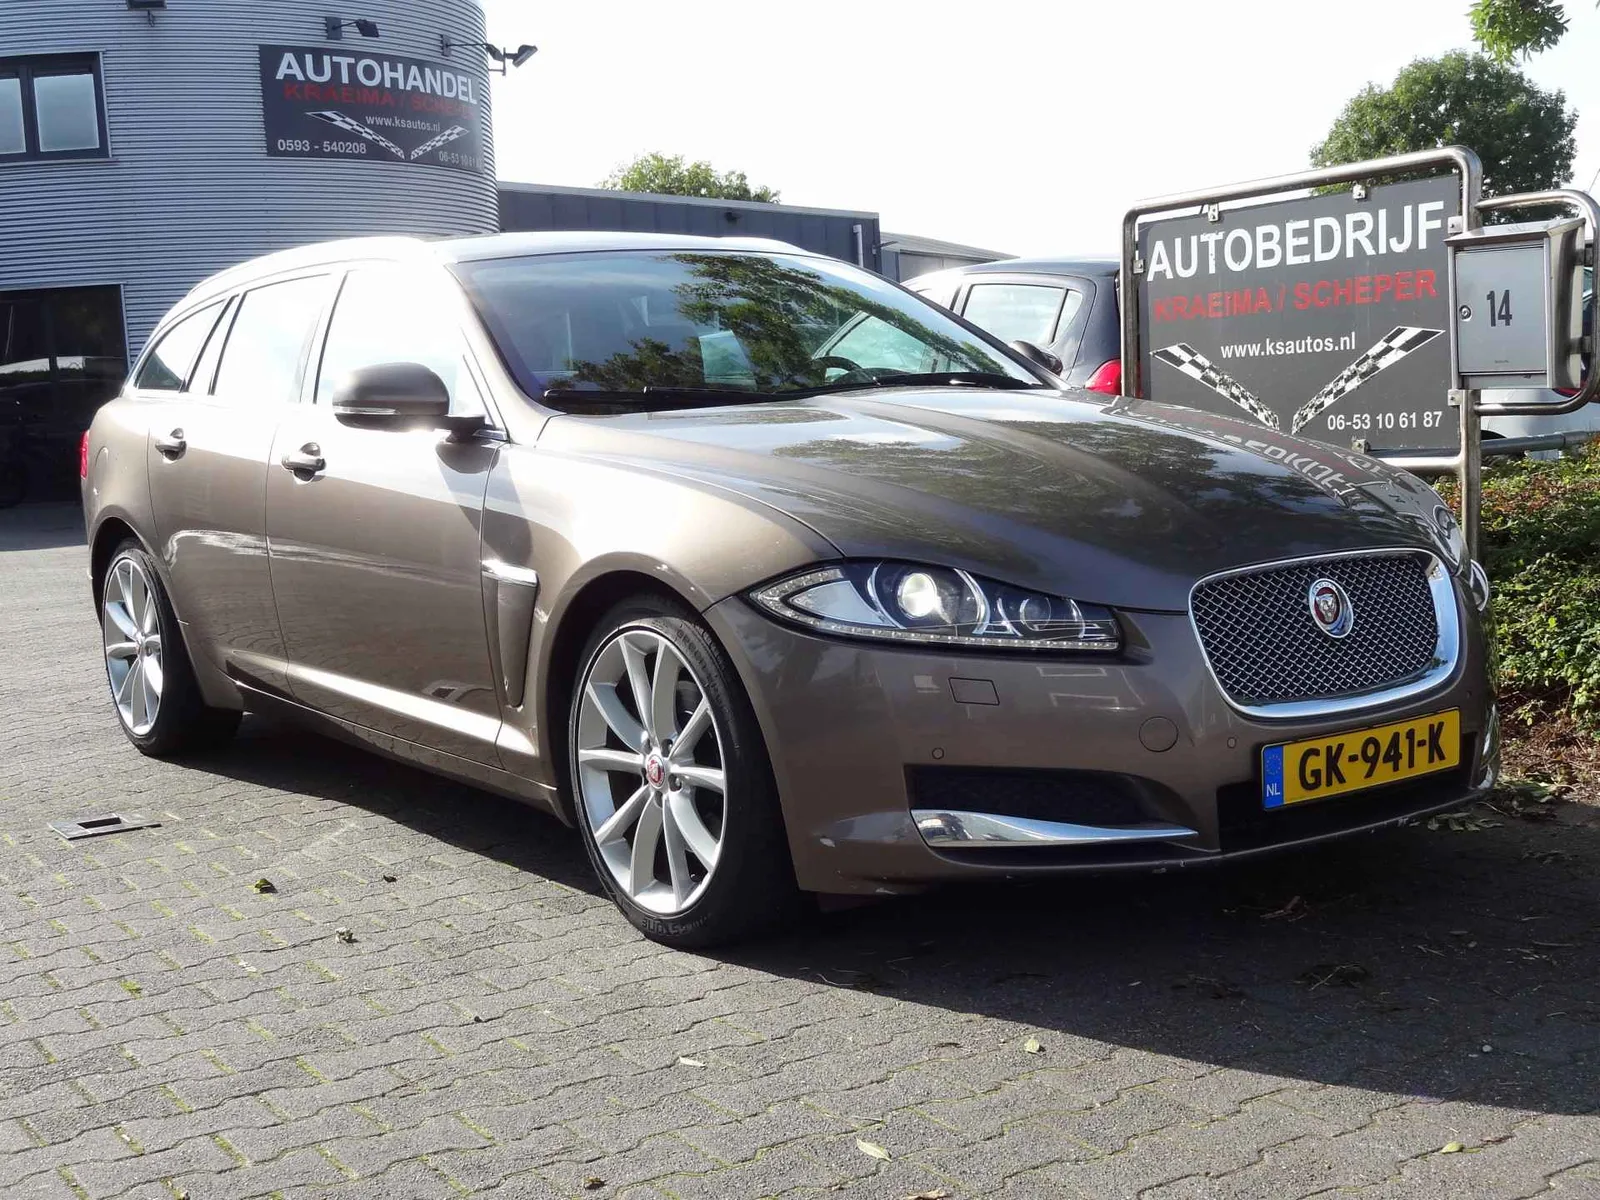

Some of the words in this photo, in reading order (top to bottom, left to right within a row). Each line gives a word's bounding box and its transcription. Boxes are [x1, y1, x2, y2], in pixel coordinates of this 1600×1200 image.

[275, 52, 478, 105] AUTOHANDEL
[283, 81, 396, 109] KRAEIMA
[411, 93, 476, 121] SCHE
[365, 115, 440, 132] www.ksautos.nl
[277, 139, 310, 152] 0593
[322, 140, 367, 154] 540208
[1146, 200, 1445, 282] AUTOBEDRIJF
[1154, 286, 1272, 323] KRAEIMA
[1293, 268, 1438, 311] SCHEPER
[1486, 289, 1513, 327] 14
[1220, 331, 1356, 359] www.ksautos.nl
[1327, 413, 1371, 430] 06-53
[1375, 412, 1395, 429] 10
[1398, 411, 1417, 429] 61
[1422, 410, 1443, 428] 87
[1298, 720, 1447, 791] GK-941-K
[1266, 783, 1281, 798] NL
